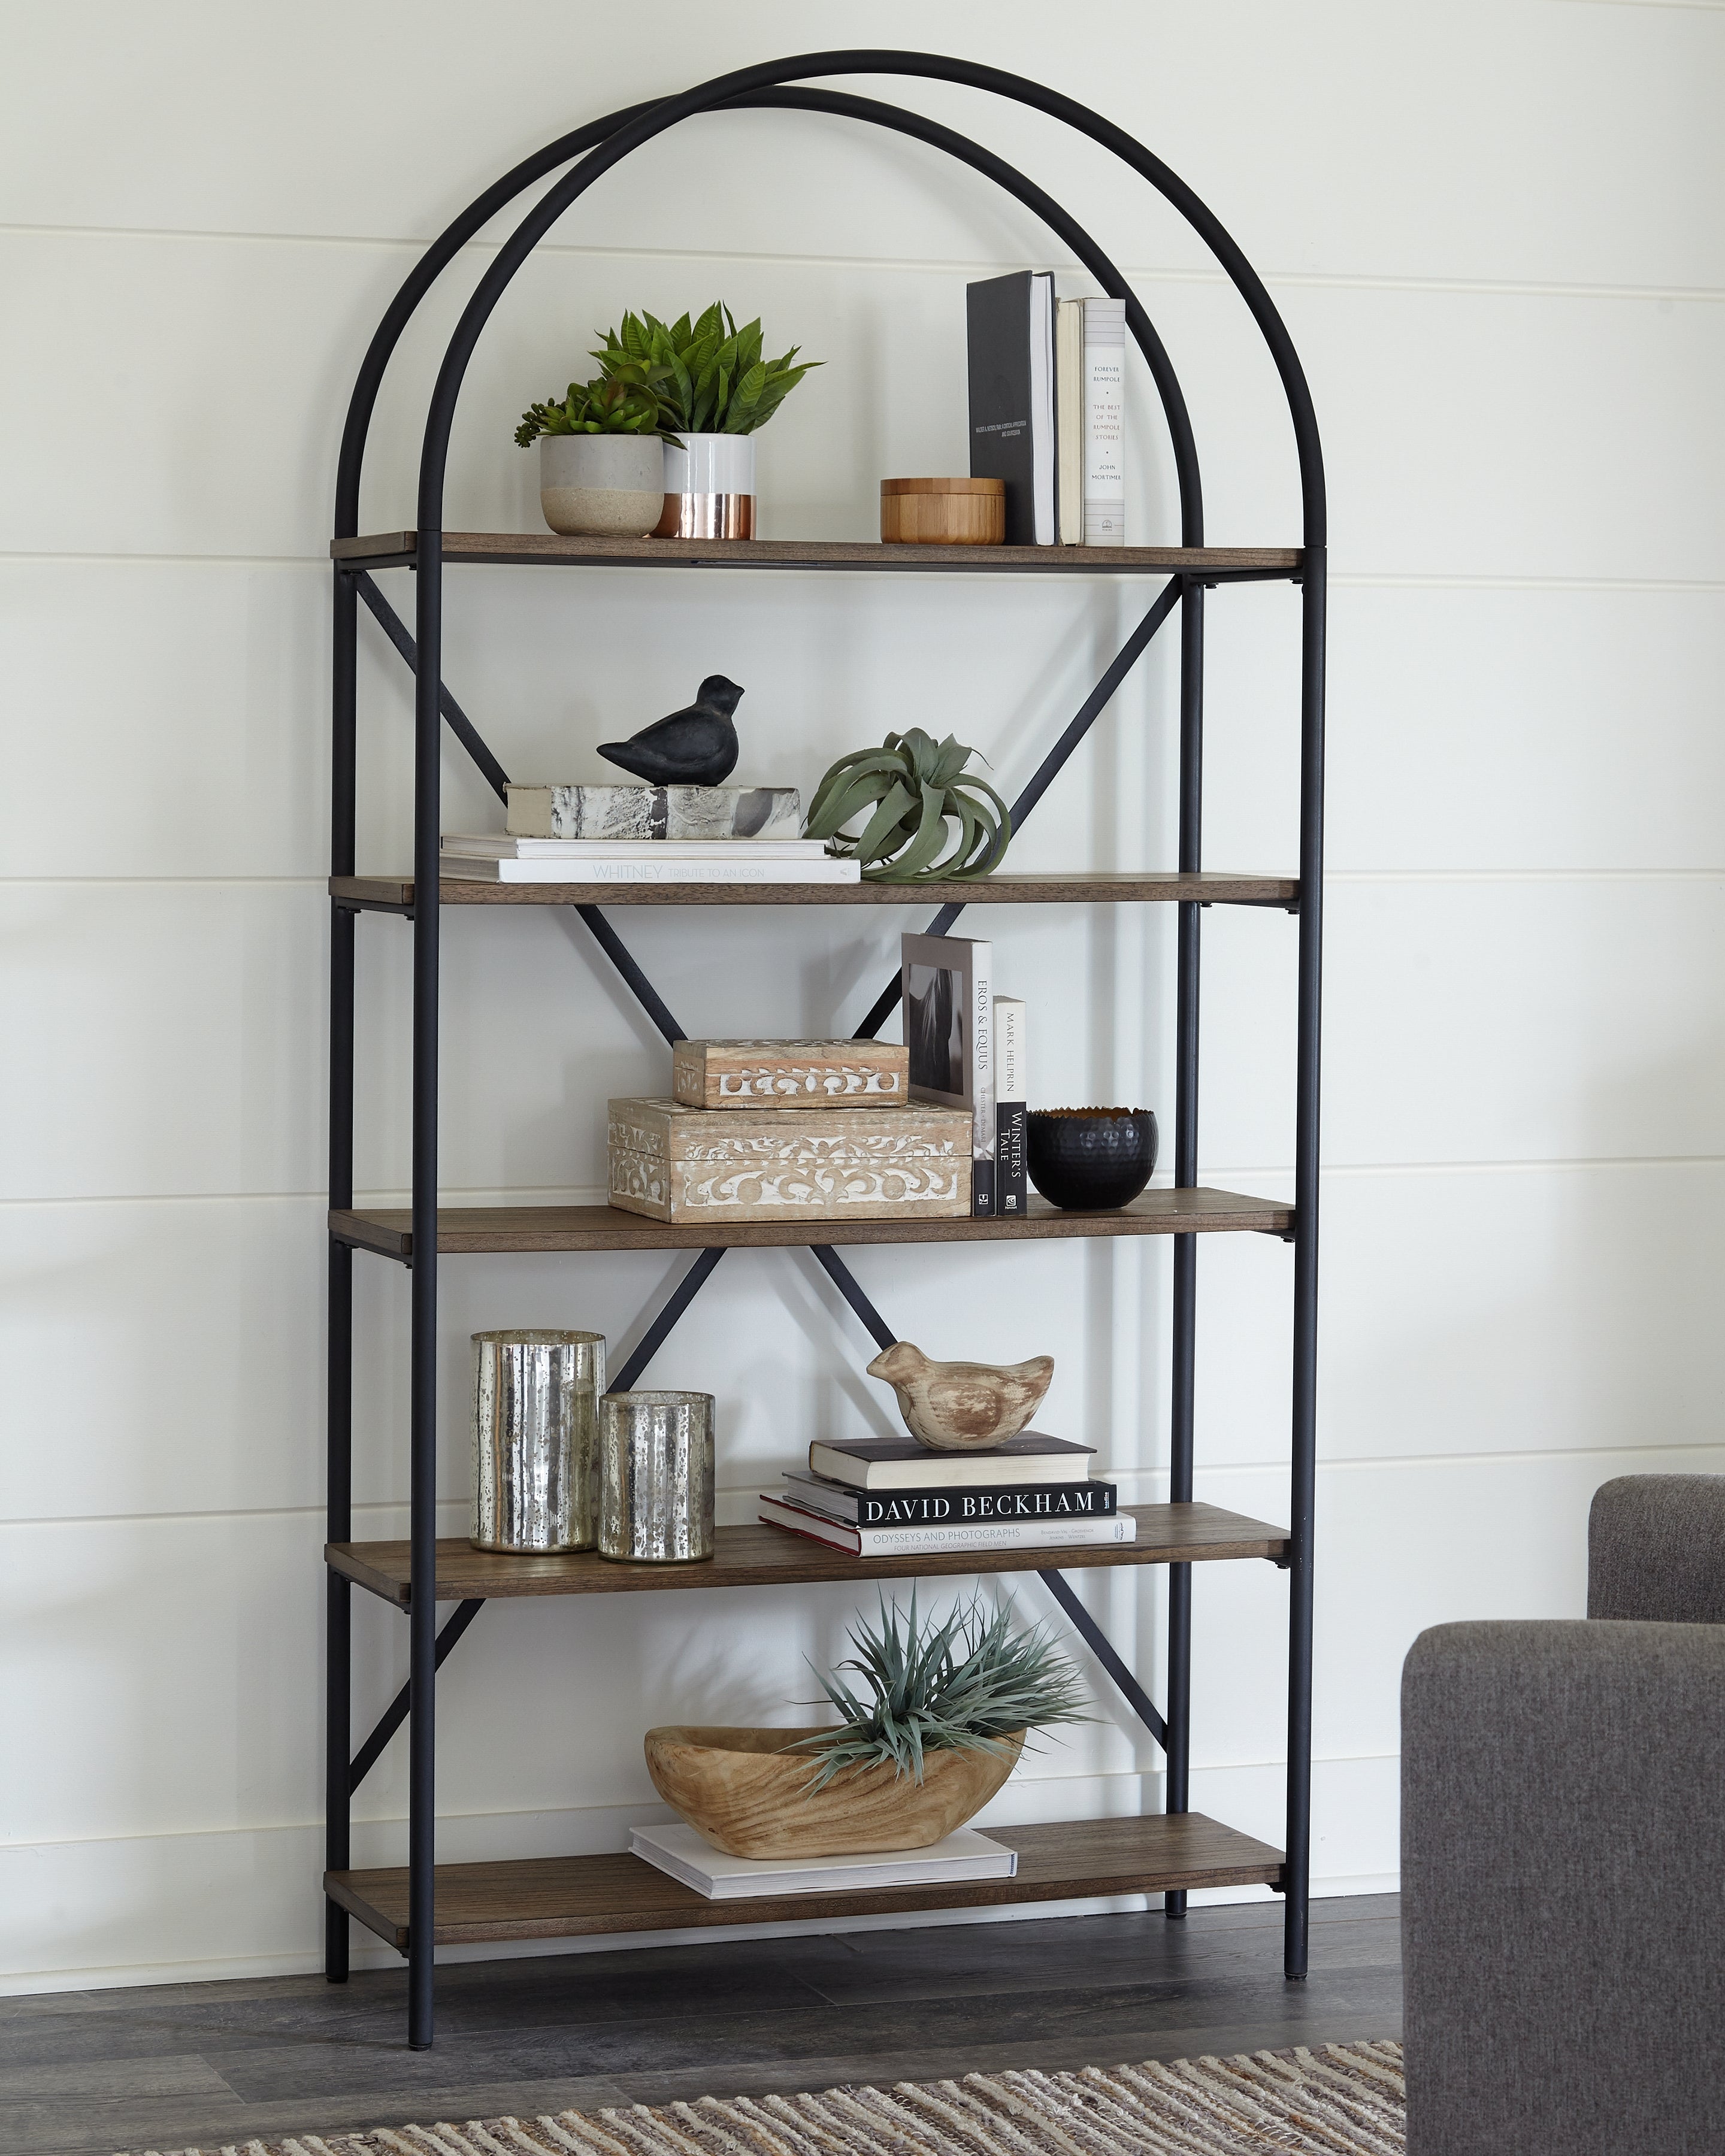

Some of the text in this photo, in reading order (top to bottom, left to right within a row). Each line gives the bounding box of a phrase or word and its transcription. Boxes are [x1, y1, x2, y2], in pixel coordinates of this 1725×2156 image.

[593, 865, 663, 879] WHITNEY
[668, 868, 764, 877] TRIBUTE TO AN ICON
[976, 980, 988, 1070] EROS & EQUUS
[1006, 1013, 1015, 1092] MARK HELPRIN
[1000, 1130, 1010, 1161] TALE
[1012, 1112, 1022, 1178] WINTER'S
[866, 1492, 1094, 1521] DAVID BECKHAM
[873, 1528, 1021, 1543] ODYSSEYS AND PHOTOGRAPHS
